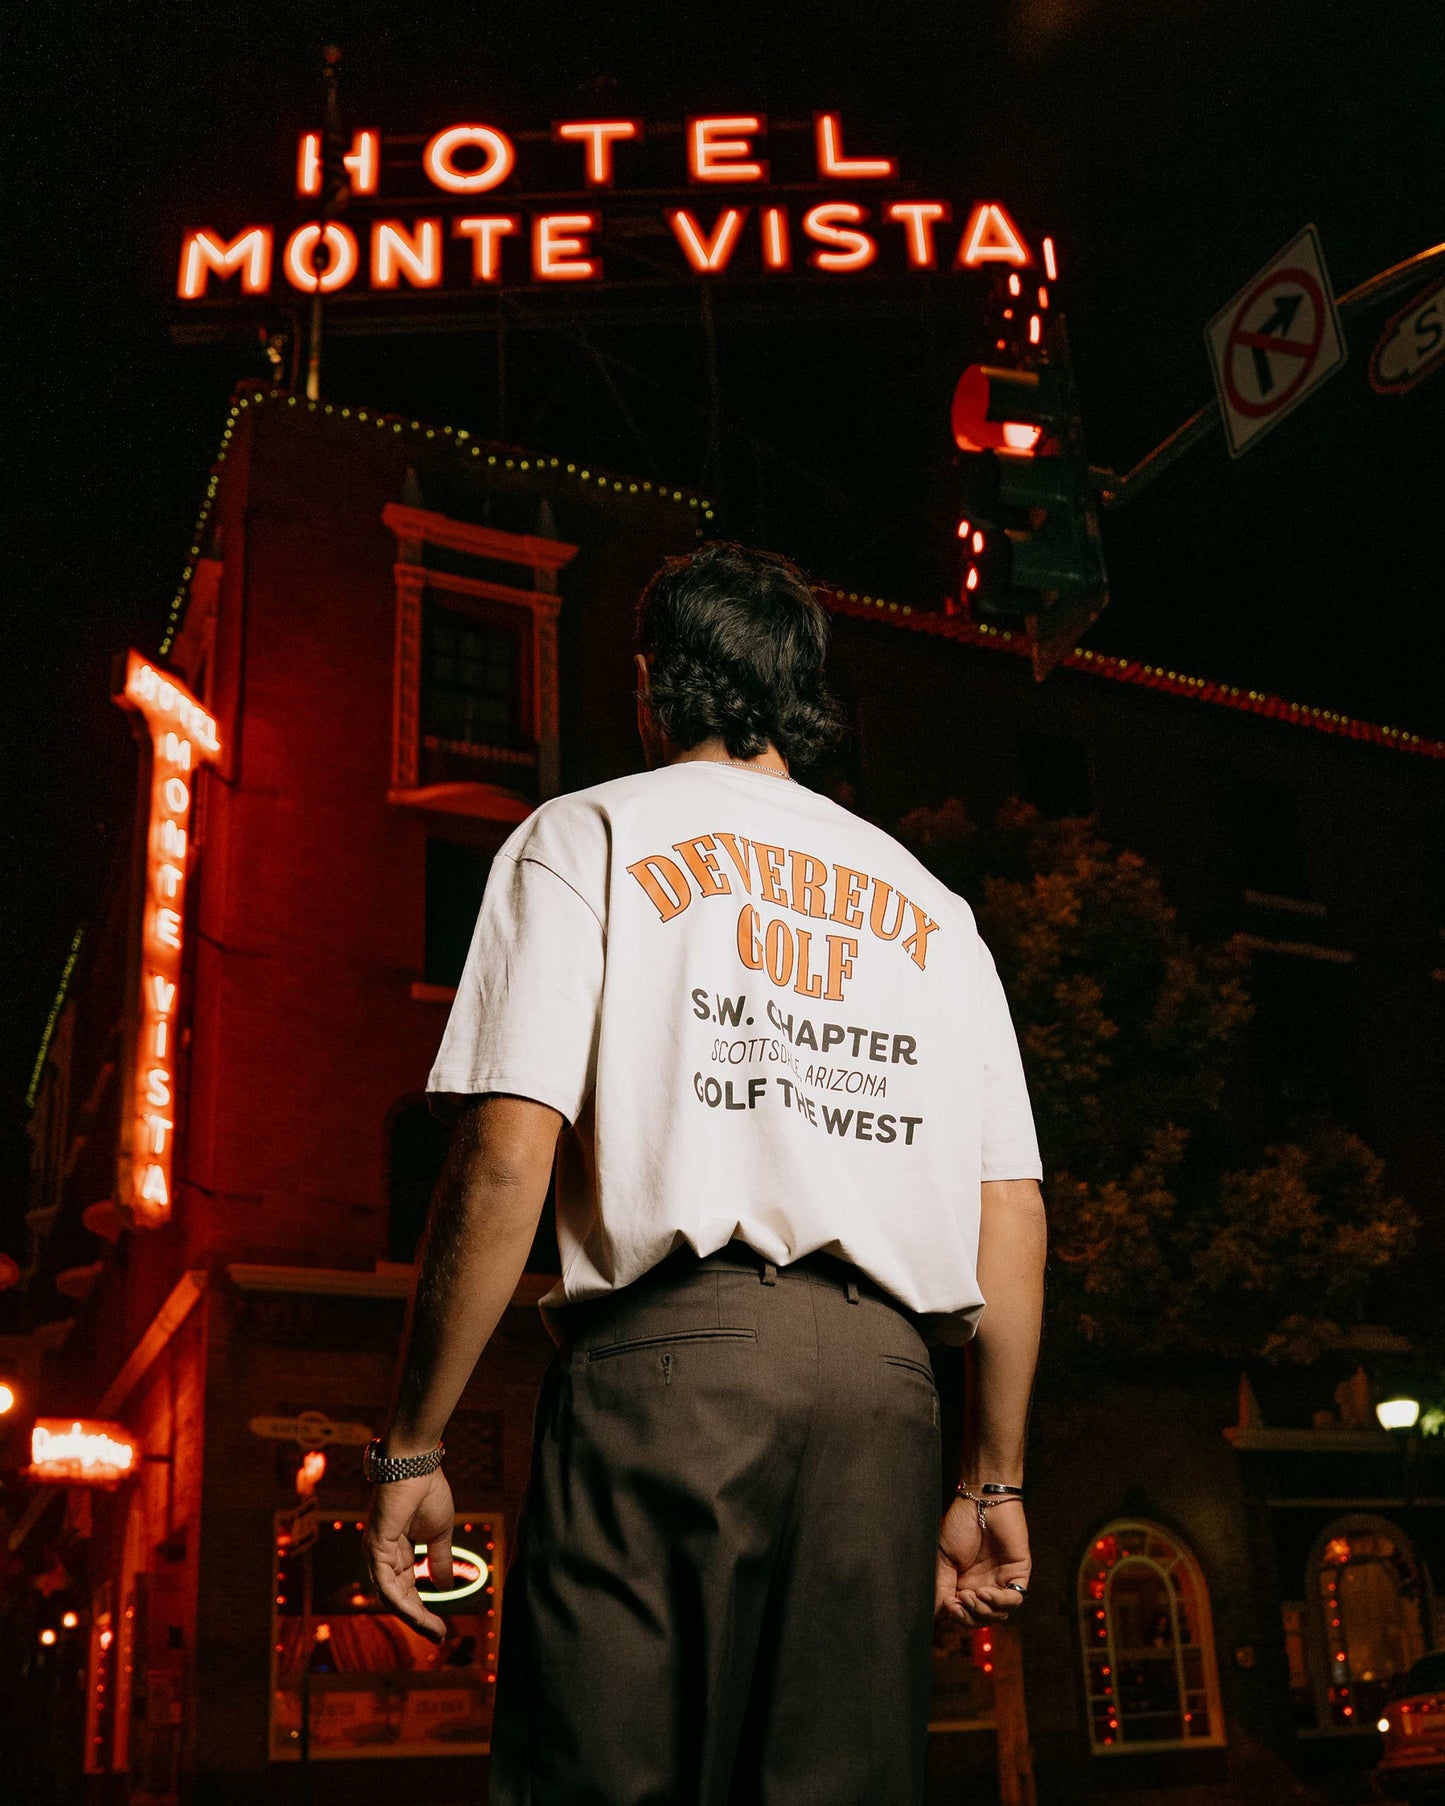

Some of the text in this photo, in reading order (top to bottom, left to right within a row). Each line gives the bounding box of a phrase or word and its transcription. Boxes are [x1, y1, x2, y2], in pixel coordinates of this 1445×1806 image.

[298, 113, 894, 195] HOTEL
[178, 202, 1031, 299] MONTE VISTA
[626, 832, 940, 972] DEVEREUX
[142, 732, 191, 1206] MONTE VISTA
[736, 903, 858, 1002] GOLF
[691, 988, 918, 1065] S.W. CHAPTER
[693, 1071, 923, 1146] GOLF THE WEST
[805, 1064, 887, 1098] ARIZONA
